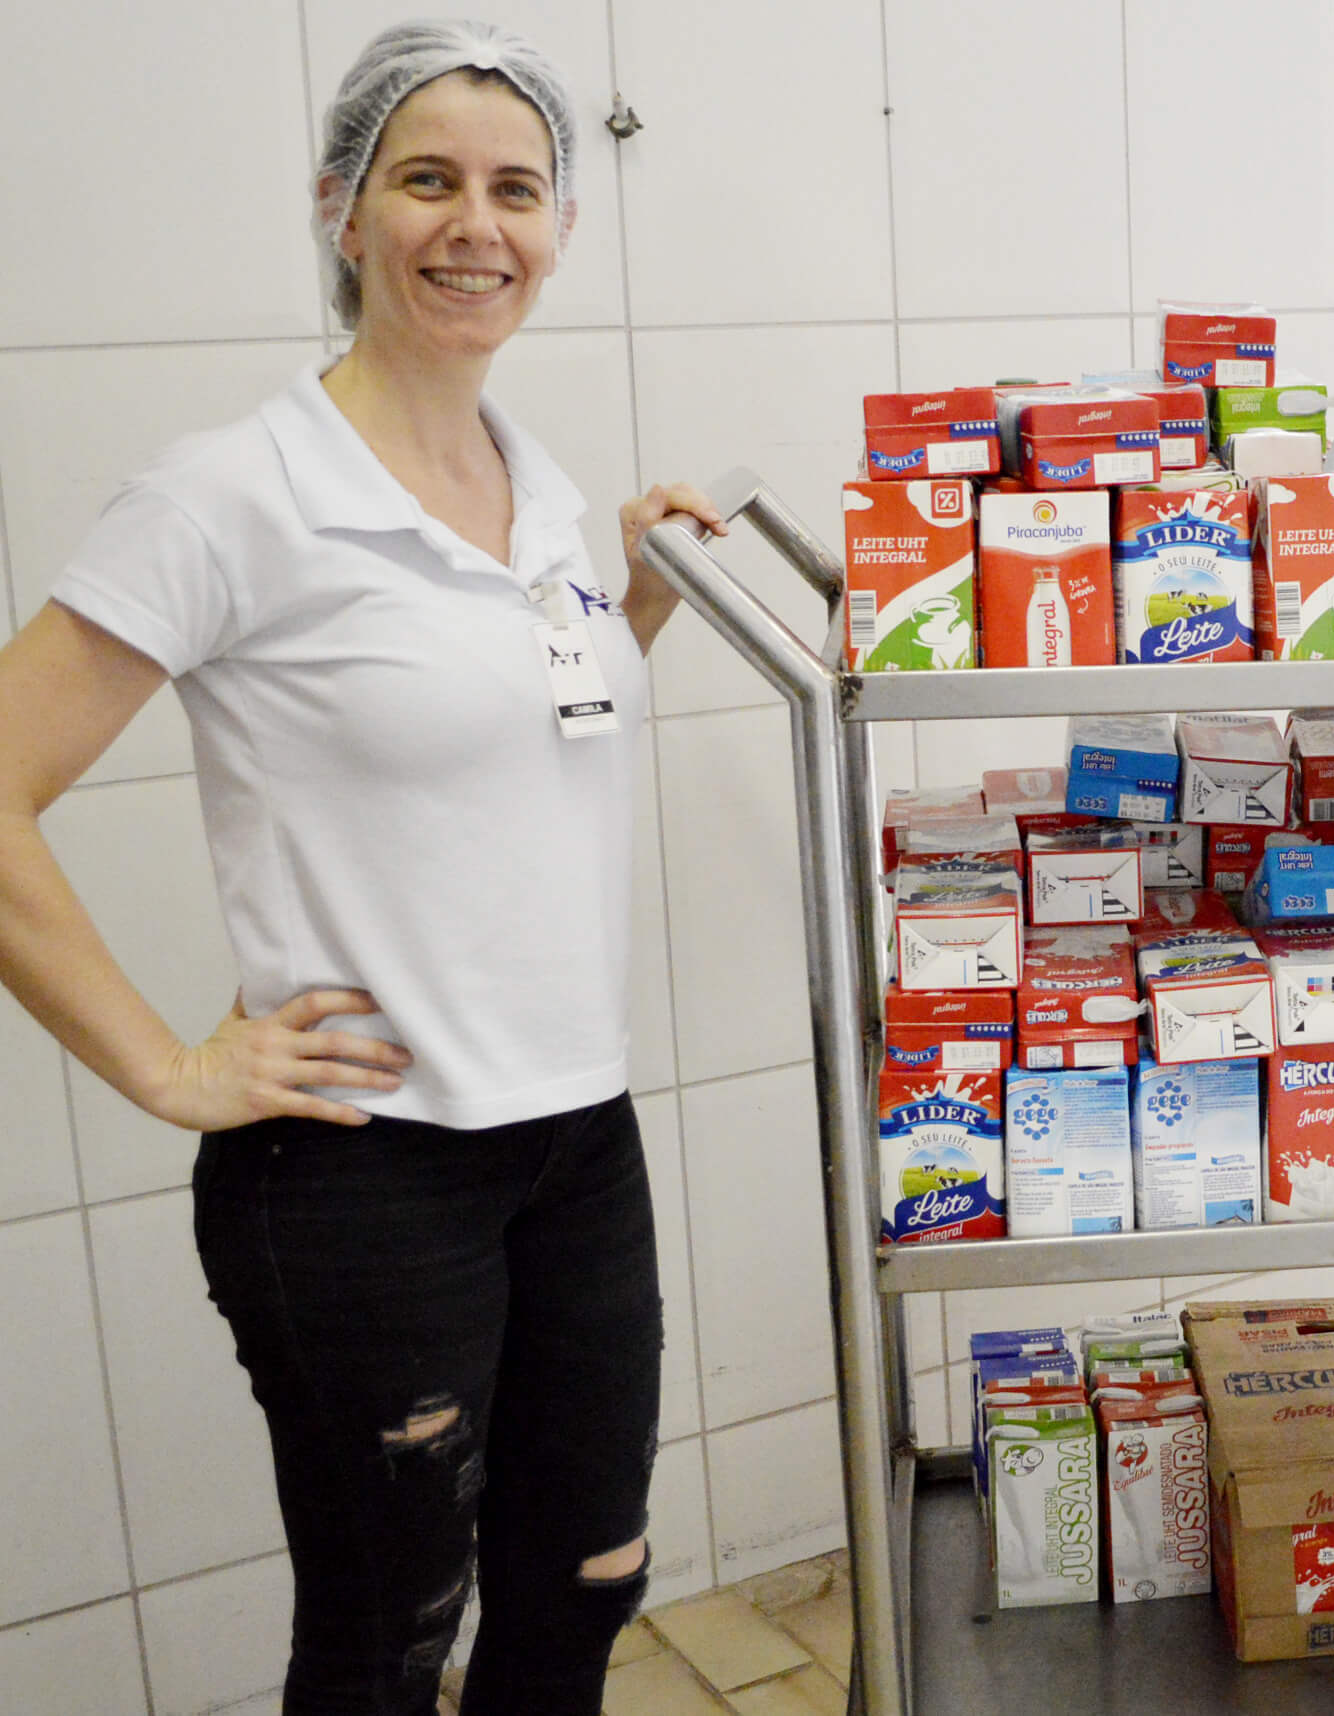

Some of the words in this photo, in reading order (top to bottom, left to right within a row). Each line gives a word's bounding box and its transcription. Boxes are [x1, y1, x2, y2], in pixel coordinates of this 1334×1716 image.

[1007, 525, 1084, 540] Piracanjuba
[1144, 525, 1229, 547] LIDER
[1278, 529, 1316, 542] LEITE
[853, 538, 895, 550] LEITE
[897, 537, 928, 549] UHT
[853, 551, 927, 564] INTEGRAL
[1166, 556, 1188, 569] SEU
[1191, 555, 1217, 572] LEITE
[1038, 600, 1063, 667] ntegral
[1154, 617, 1224, 656] Leite
[1279, 850, 1313, 862] Integral
[1147, 1094, 1191, 1112] gege
[900, 1105, 978, 1125] LIDER
[1013, 1108, 1058, 1126] gege
[921, 1133, 939, 1144] SEU
[942, 1134, 969, 1148] LEITE
[907, 1189, 973, 1226] Leite
[919, 1223, 964, 1243] integral
[1160, 1442, 1175, 1517] SEMIDESNATADO
[1172, 1423, 1209, 1569] JUSSARA
[1044, 1484, 1058, 1529] INTEGRAL
[1057, 1435, 1094, 1585] JUSSARA
[1163, 1520, 1176, 1538] UHT
[1292, 1525, 1318, 1547] gral
[1045, 1530, 1060, 1552] UHT
[1163, 1538, 1177, 1564] LEITE
[1118, 1578, 1128, 1587] 1L
